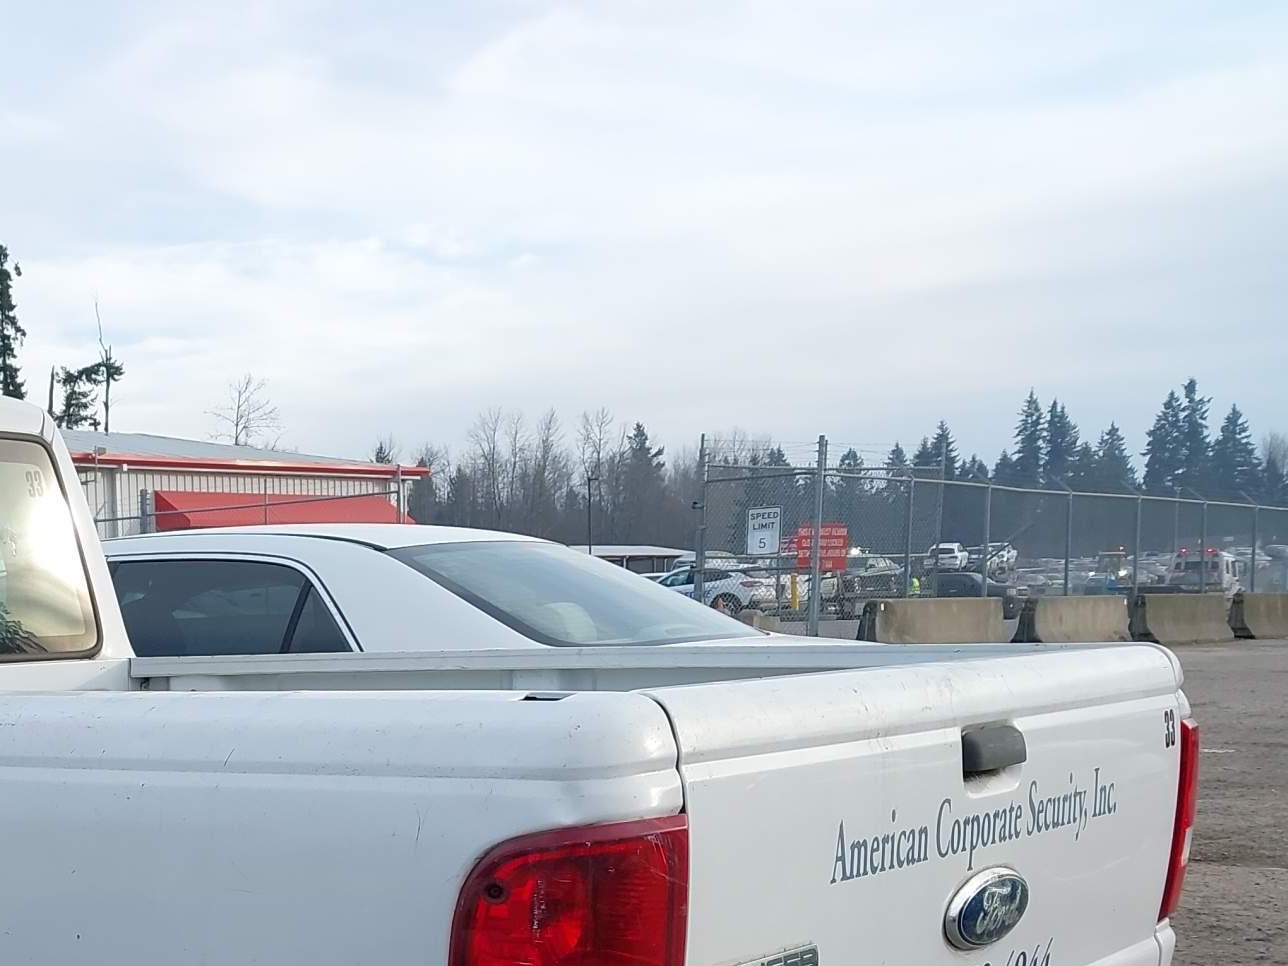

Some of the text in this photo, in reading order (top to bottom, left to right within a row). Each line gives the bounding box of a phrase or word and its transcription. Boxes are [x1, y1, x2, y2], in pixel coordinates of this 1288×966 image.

[24, 470, 43, 497] 33
[750, 511, 779, 521] SPEED
[752, 521, 776, 530] LIMIT
[758, 537, 767, 549] 5
[1163, 708, 1176, 749] 33
[830, 767, 1118, 885] American Corporate Security, Inc.
[974, 880, 1023, 936] Ford
